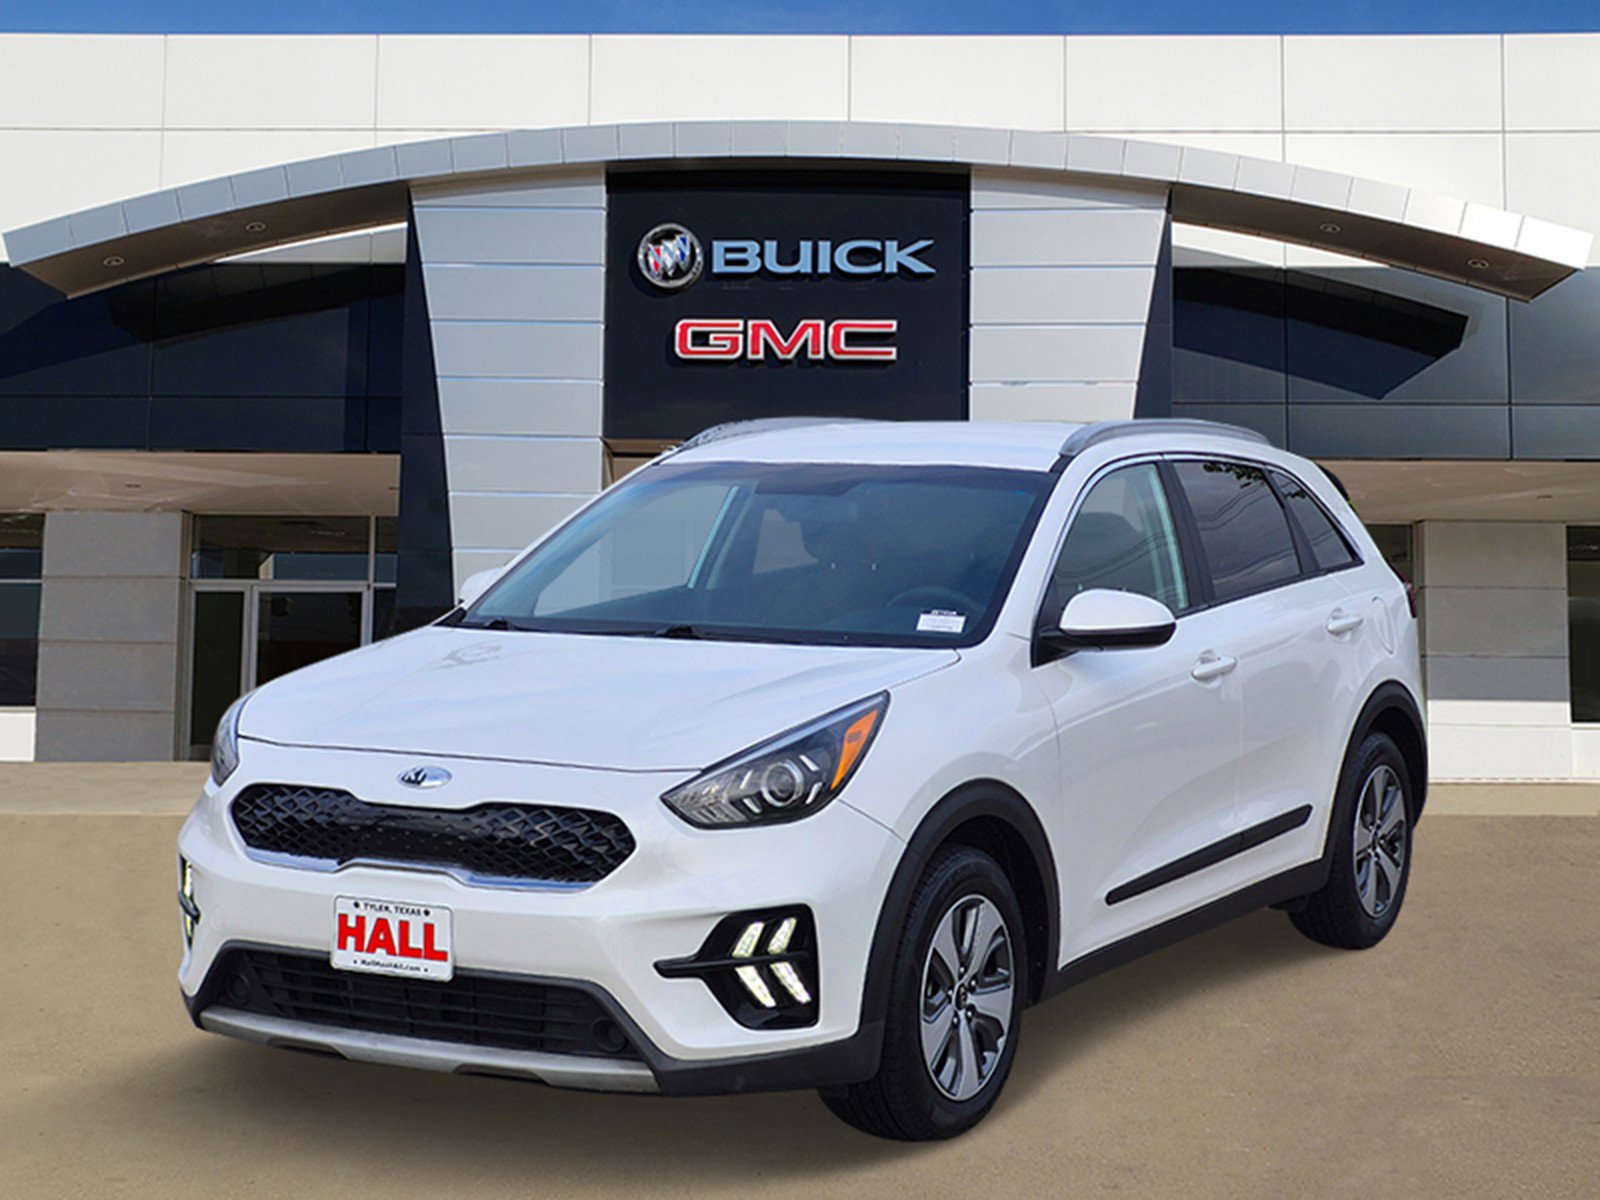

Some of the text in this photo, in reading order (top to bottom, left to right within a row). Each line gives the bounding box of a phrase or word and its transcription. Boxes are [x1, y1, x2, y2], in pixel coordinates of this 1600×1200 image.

[711, 239, 936, 274] BUICK
[674, 318, 898, 360] GMC
[394, 906, 421, 915] TEXAS
[337, 913, 448, 962] HALL
